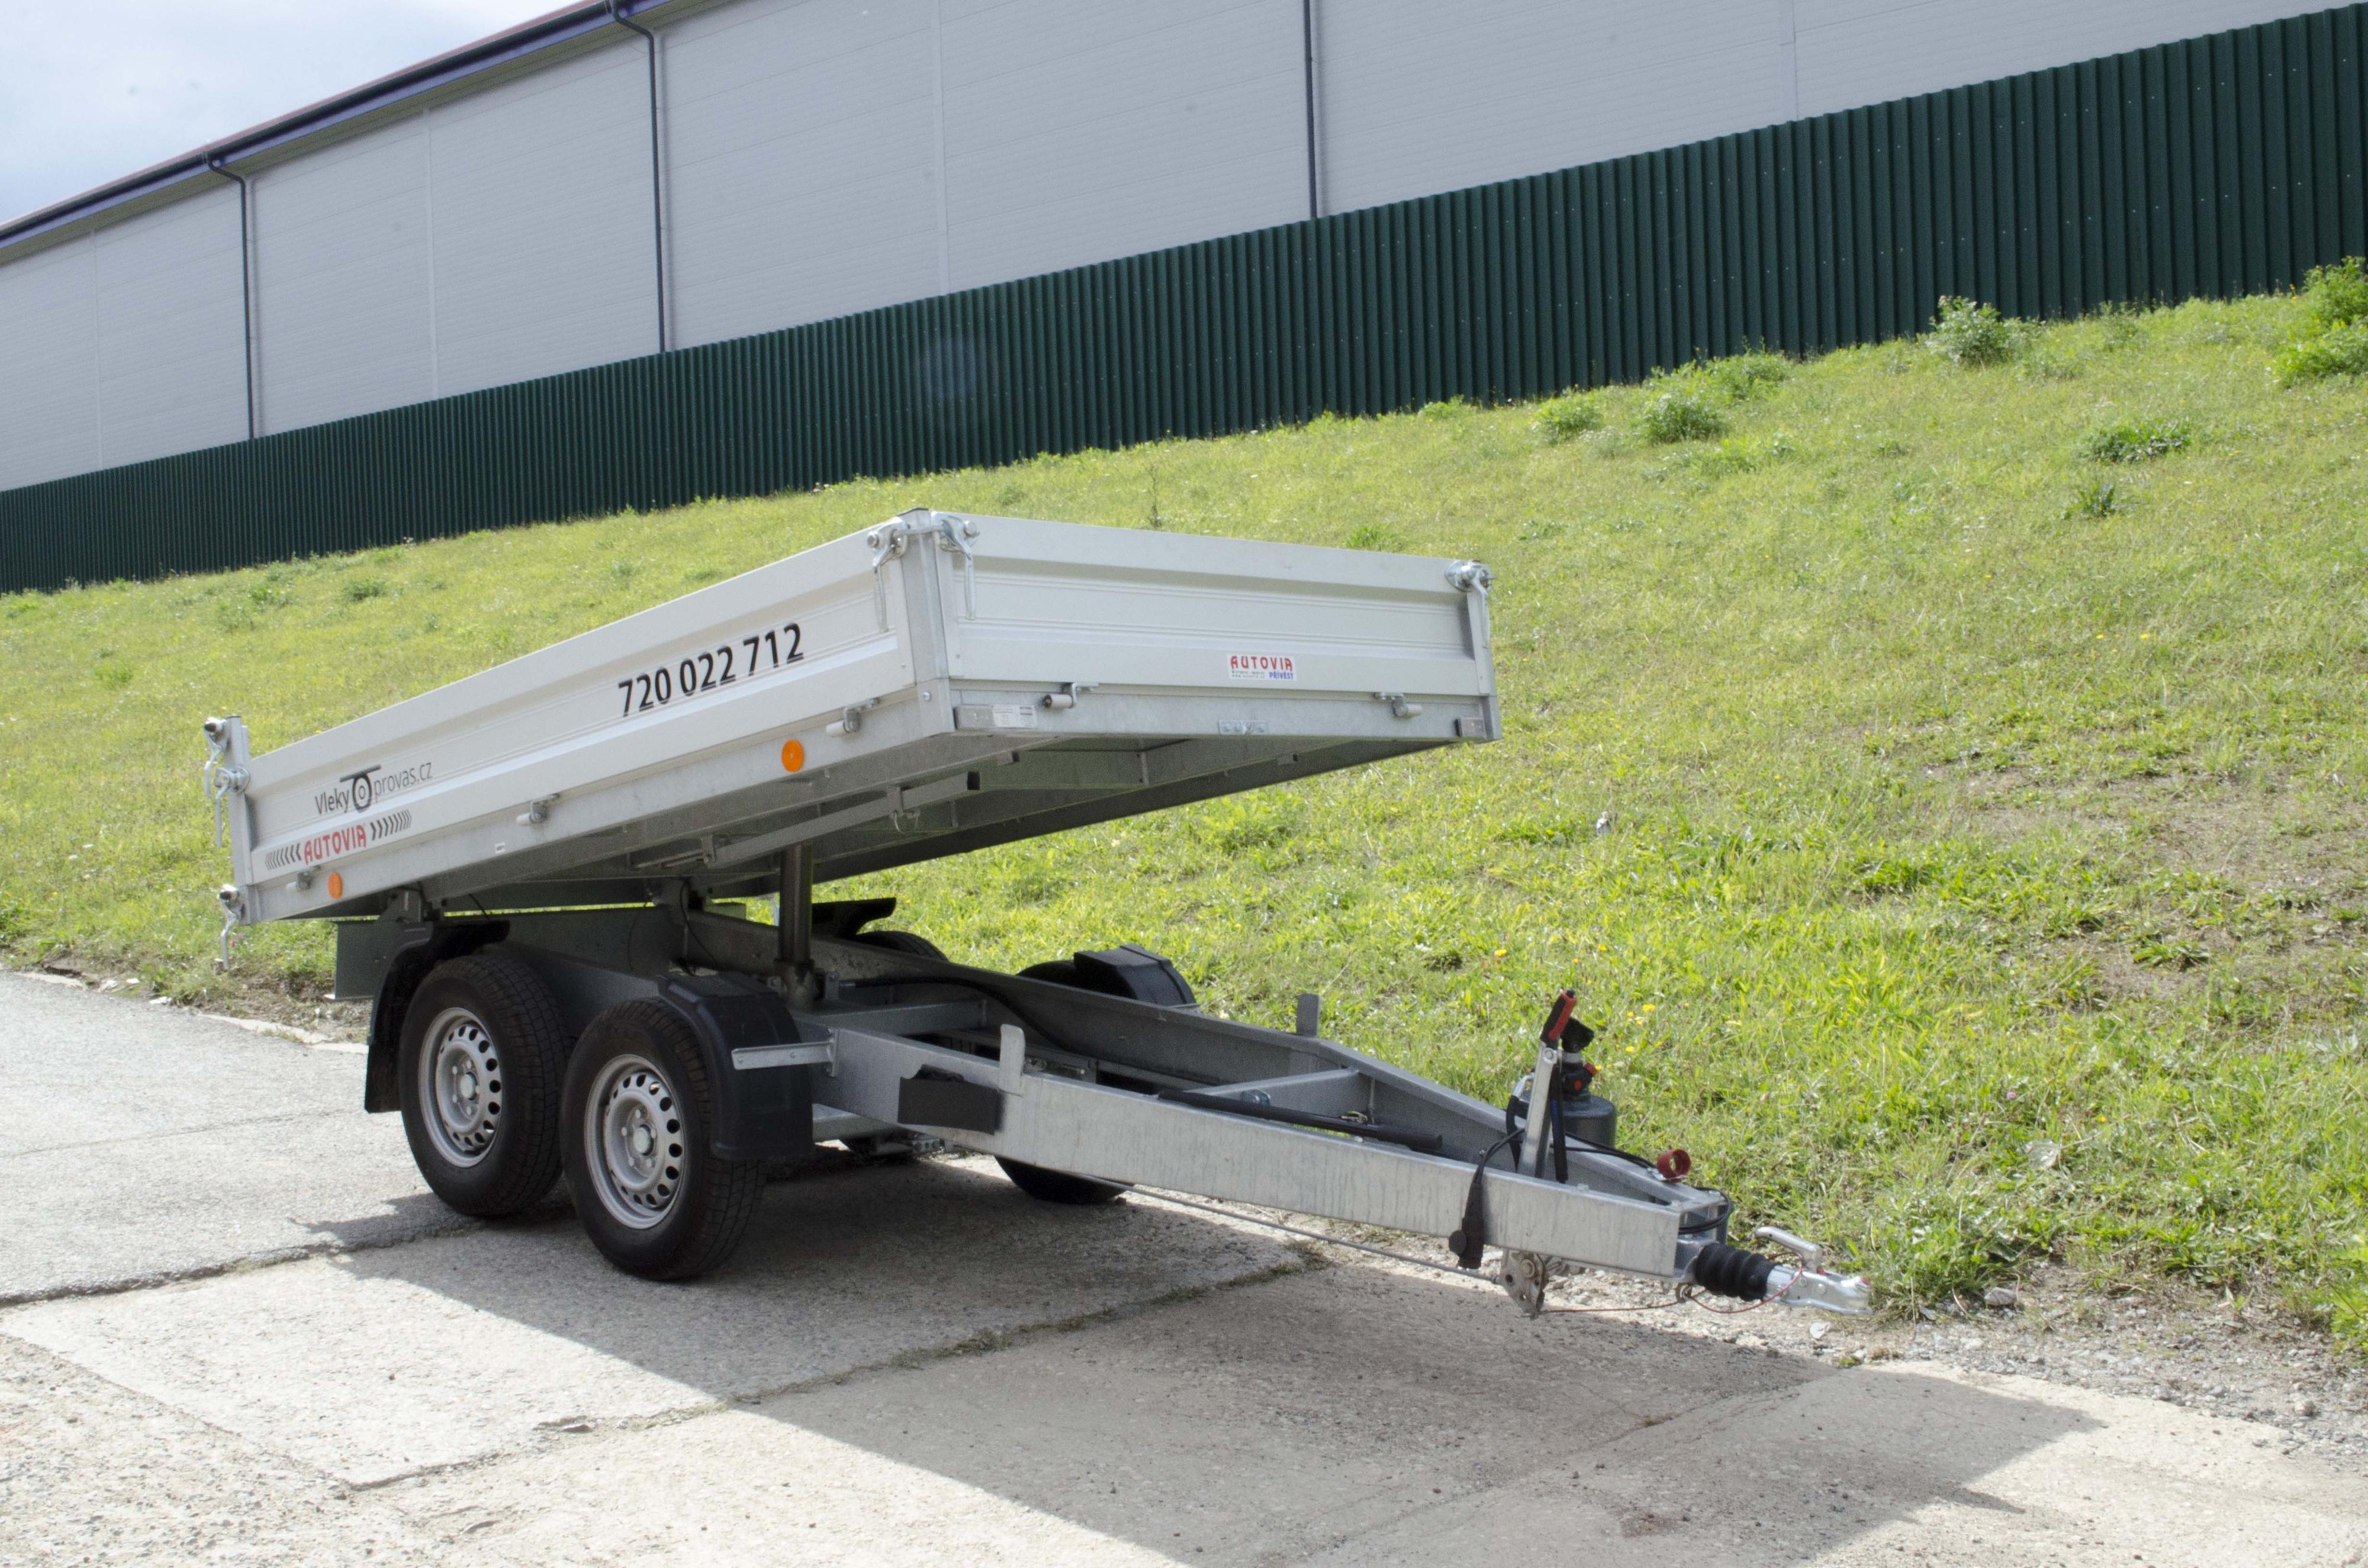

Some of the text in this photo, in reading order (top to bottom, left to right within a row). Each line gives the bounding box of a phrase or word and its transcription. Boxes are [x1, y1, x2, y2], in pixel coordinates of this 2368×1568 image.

[619, 623, 804, 717] 720 022 712
[1230, 655, 1293, 671] AUTOVIA
[304, 825, 366, 865] AUTOVIA
